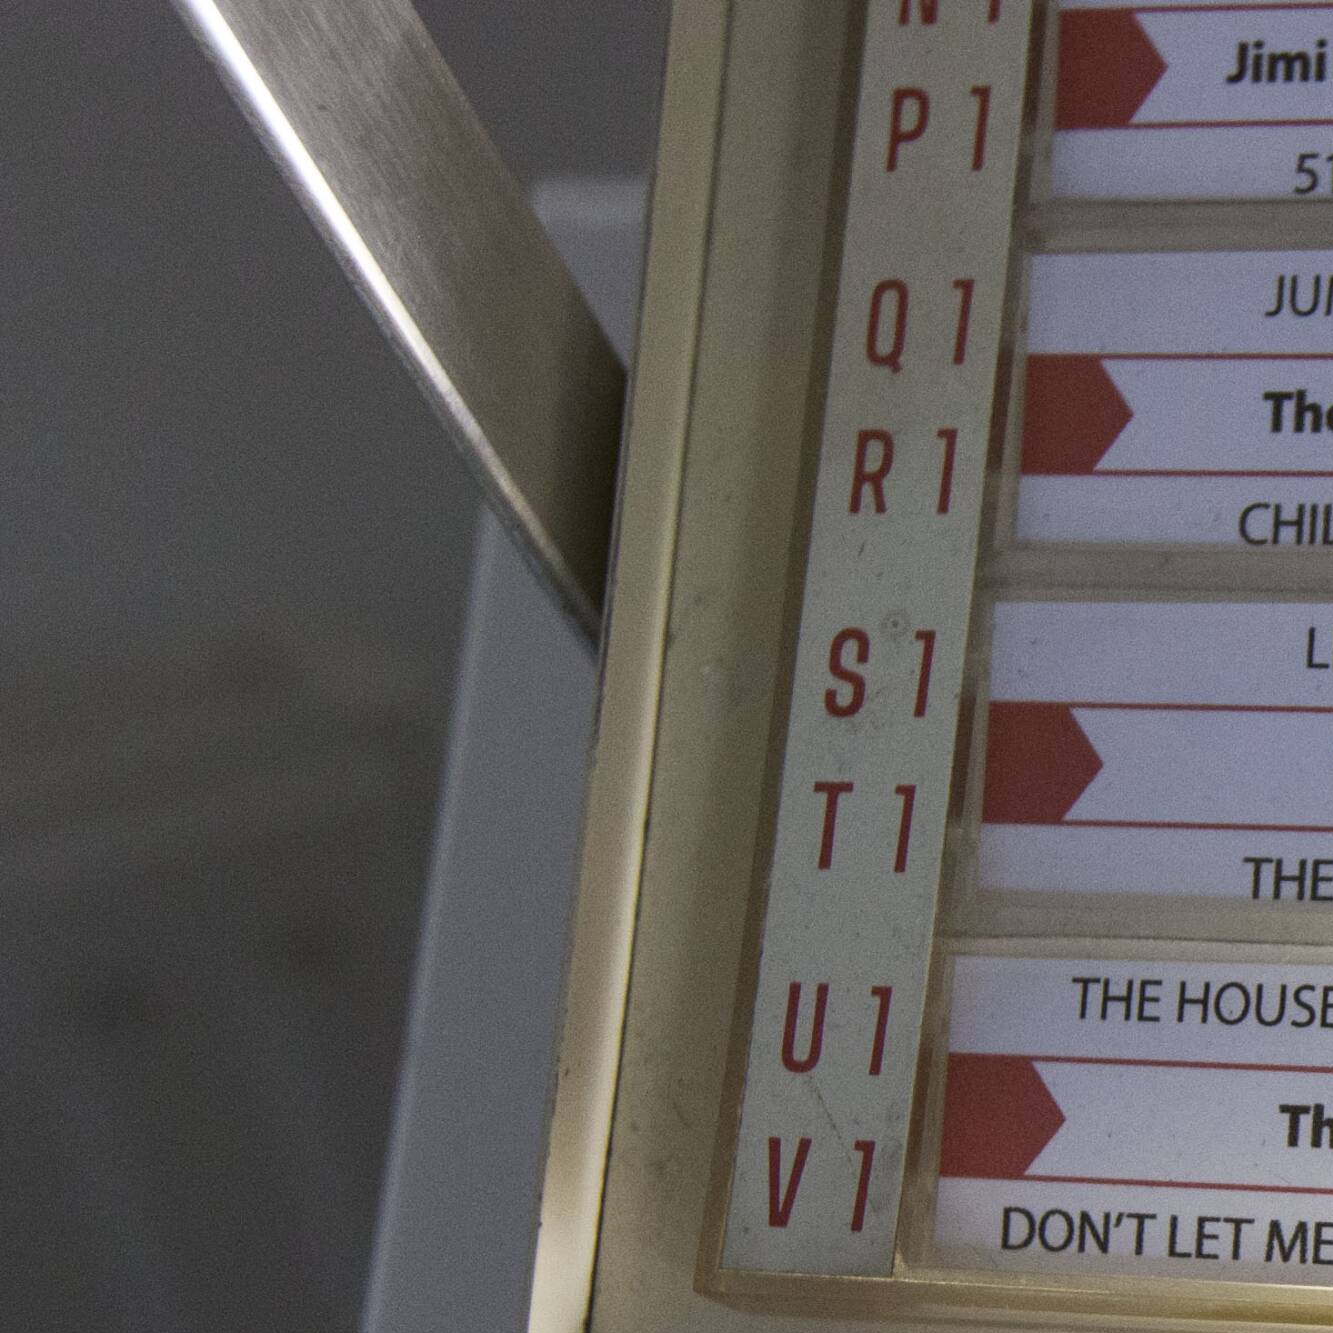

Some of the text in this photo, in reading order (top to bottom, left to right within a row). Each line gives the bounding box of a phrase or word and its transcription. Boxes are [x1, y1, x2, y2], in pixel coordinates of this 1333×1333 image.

[1226, 39, 1327, 85] Jimi
[1070, 975, 1163, 1024] THE
[1000, 1206, 1157, 1253] DON'T
[1167, 1215, 1254, 1262] LET
